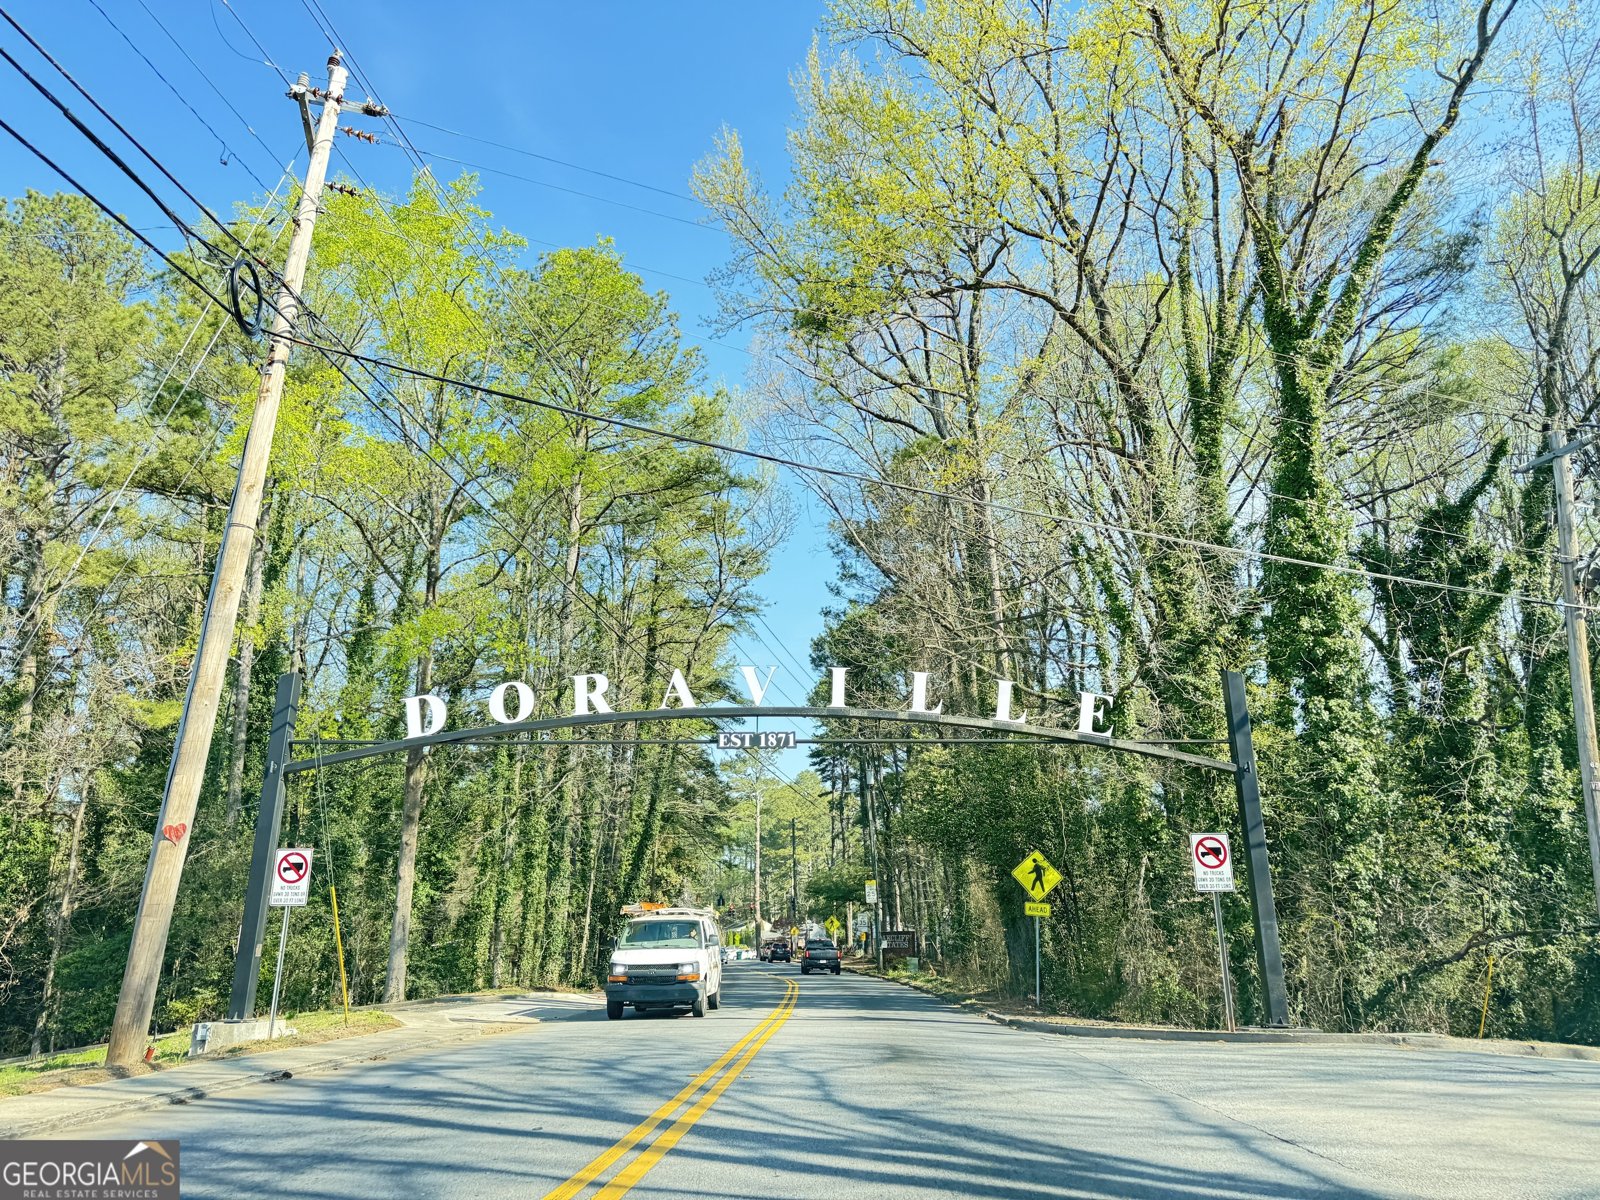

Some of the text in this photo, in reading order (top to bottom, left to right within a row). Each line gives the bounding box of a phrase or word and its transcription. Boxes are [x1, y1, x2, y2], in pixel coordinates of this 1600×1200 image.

[400, 666, 1115, 740] DORAVILLE
[719, 733, 795, 747] EST 1871
[1028, 906, 1047, 914] AHEAD
